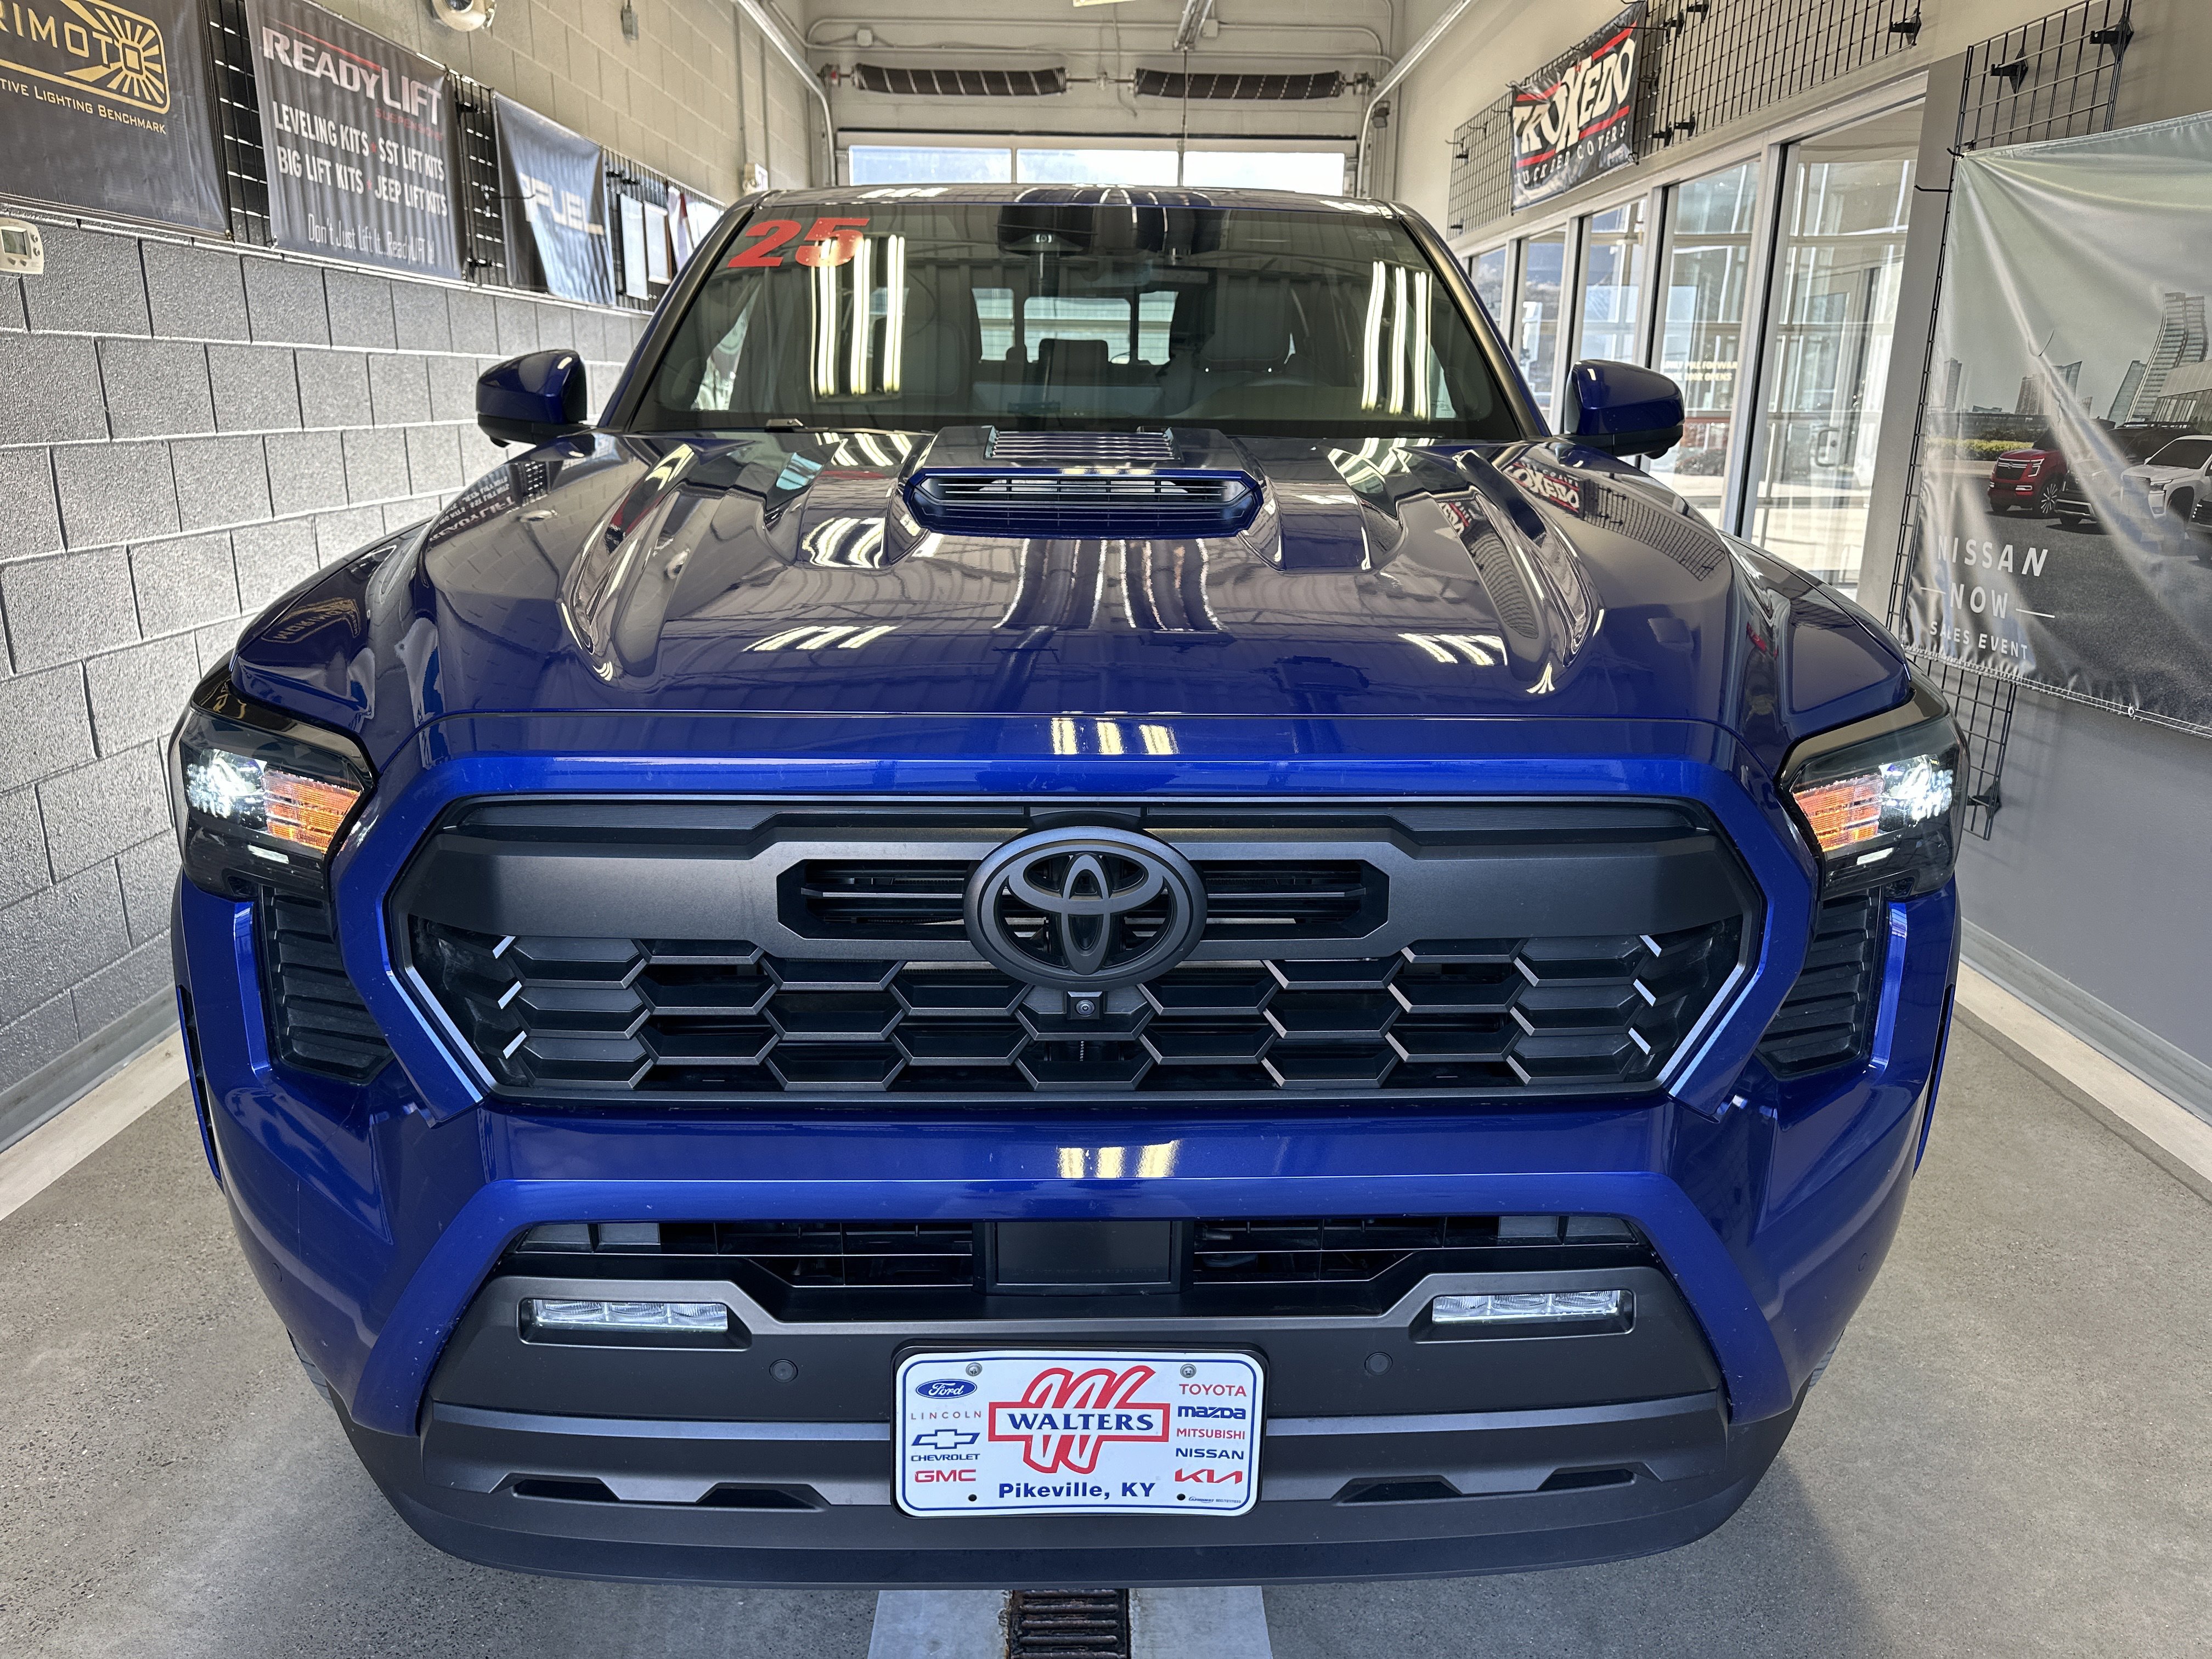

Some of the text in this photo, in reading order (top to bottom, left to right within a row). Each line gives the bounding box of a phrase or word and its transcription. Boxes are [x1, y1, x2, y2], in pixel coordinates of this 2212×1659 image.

[262, 26, 442, 126] READYLIFT
[273, 101, 445, 182] LEVELING KITS SST LIFT KITS
[1577, 120, 1626, 160] COVERS
[276, 145, 448, 217] BIG LIFT KITS JEEP LIFT KITS
[308, 212, 334, 246] Don't
[335, 220, 357, 250] Just
[727, 218, 870, 267] 25
[1938, 535, 2048, 577] NISSAN
[1950, 583, 2008, 619] NOW
[1930, 621, 2028, 659] SALES EVENT
[928, 1382, 964, 1396] Ford
[1179, 1384, 1246, 1397] TOYOTA
[911, 1410, 981, 1420] LINCOLN
[1007, 1413, 1154, 1431] WALTERS
[1176, 1429, 1245, 1439] MITSUBISHI
[911, 1453, 980, 1462] CHEVROLET
[1176, 1448, 1244, 1460] NISSAN
[915, 1469, 977, 1482] GMC
[998, 1482, 1155, 1499] Pikeville, KY
